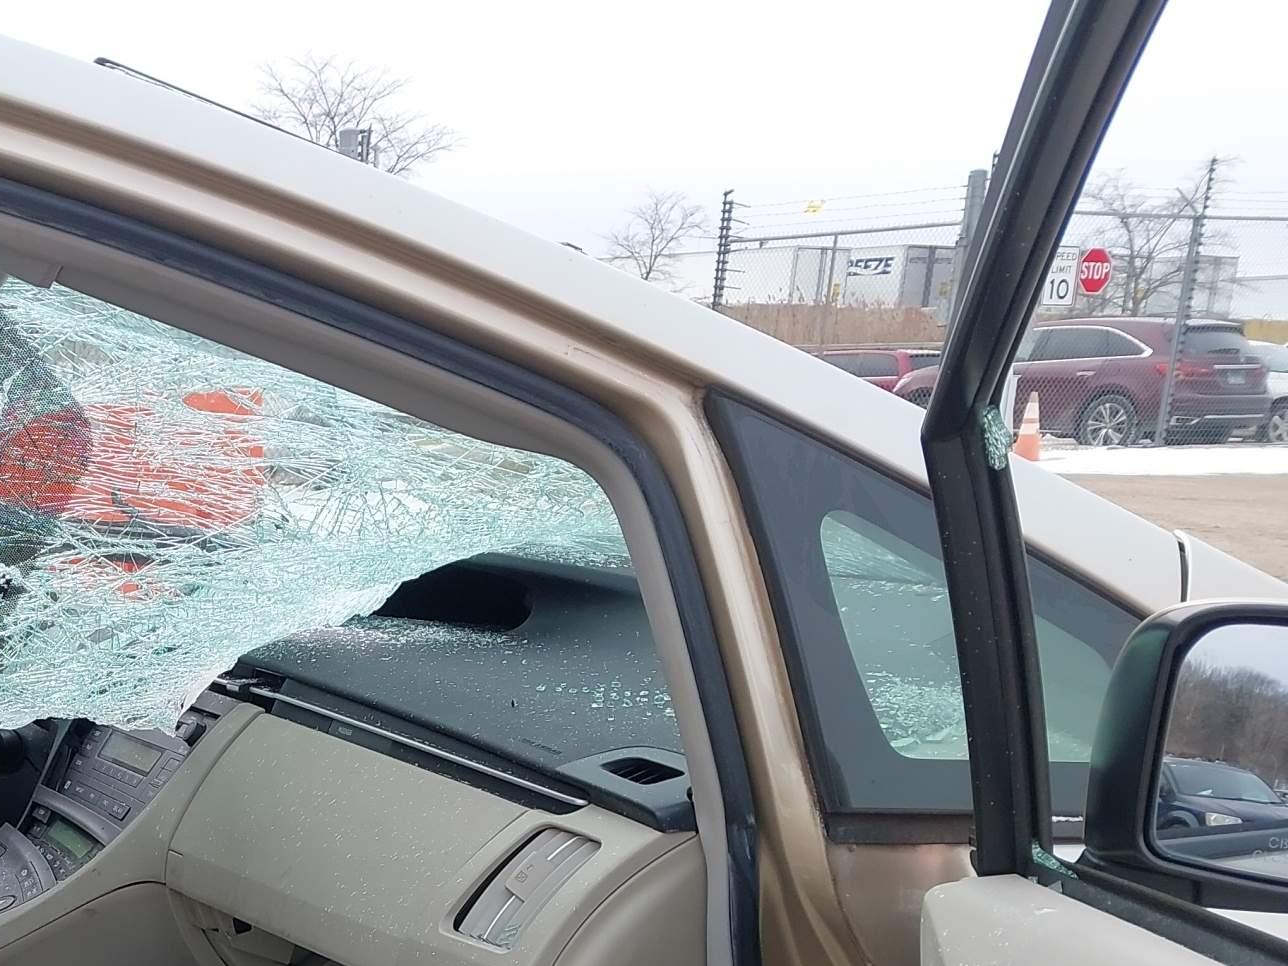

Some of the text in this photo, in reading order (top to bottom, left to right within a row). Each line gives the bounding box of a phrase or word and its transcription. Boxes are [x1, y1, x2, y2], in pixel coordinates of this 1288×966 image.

[1056, 251, 1078, 261] PEED
[1051, 265, 1073, 274] LIMIT
[1080, 262, 1110, 280] STOP
[1050, 278, 1069, 299] 10
